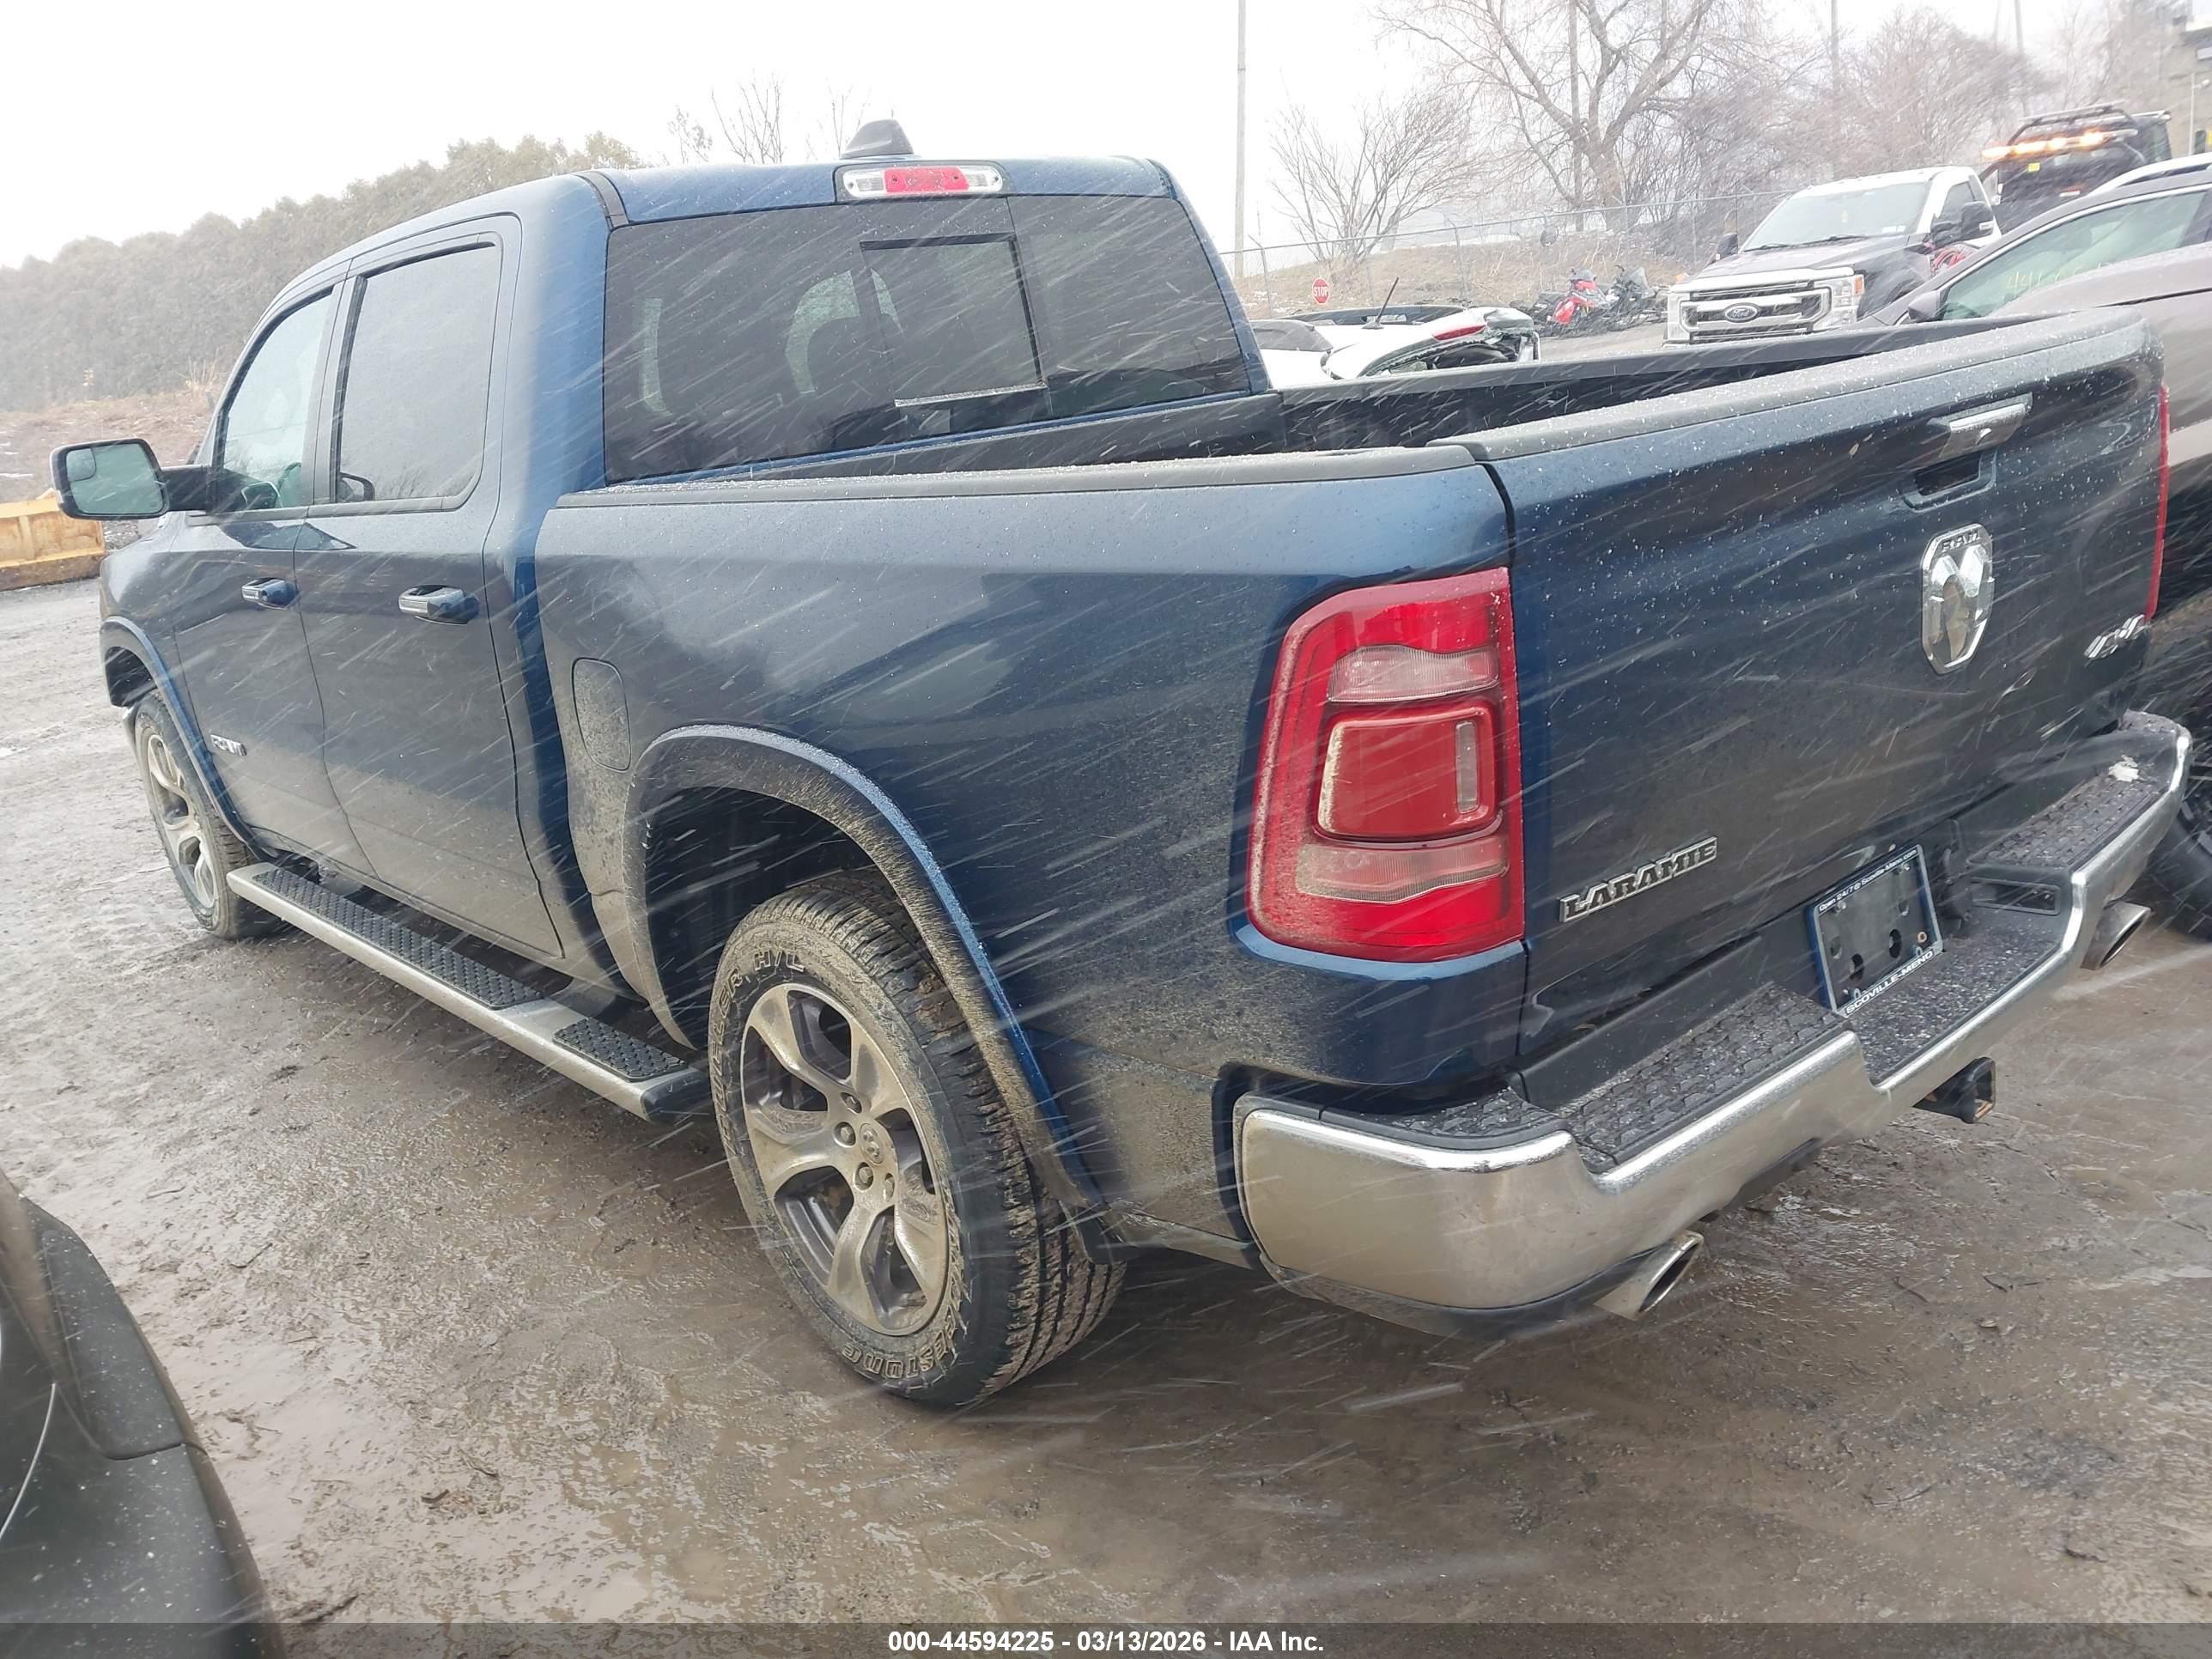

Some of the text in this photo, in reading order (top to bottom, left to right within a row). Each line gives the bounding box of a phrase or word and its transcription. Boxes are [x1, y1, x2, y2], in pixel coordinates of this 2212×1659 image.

[1314, 286, 1328, 296] STOP
[1942, 530, 1981, 553] RAM
[1559, 836, 1717, 922] LARAMIE
[1819, 898, 1836, 911] Open
[1846, 951, 1934, 1014] SCOVILLE-MENO
